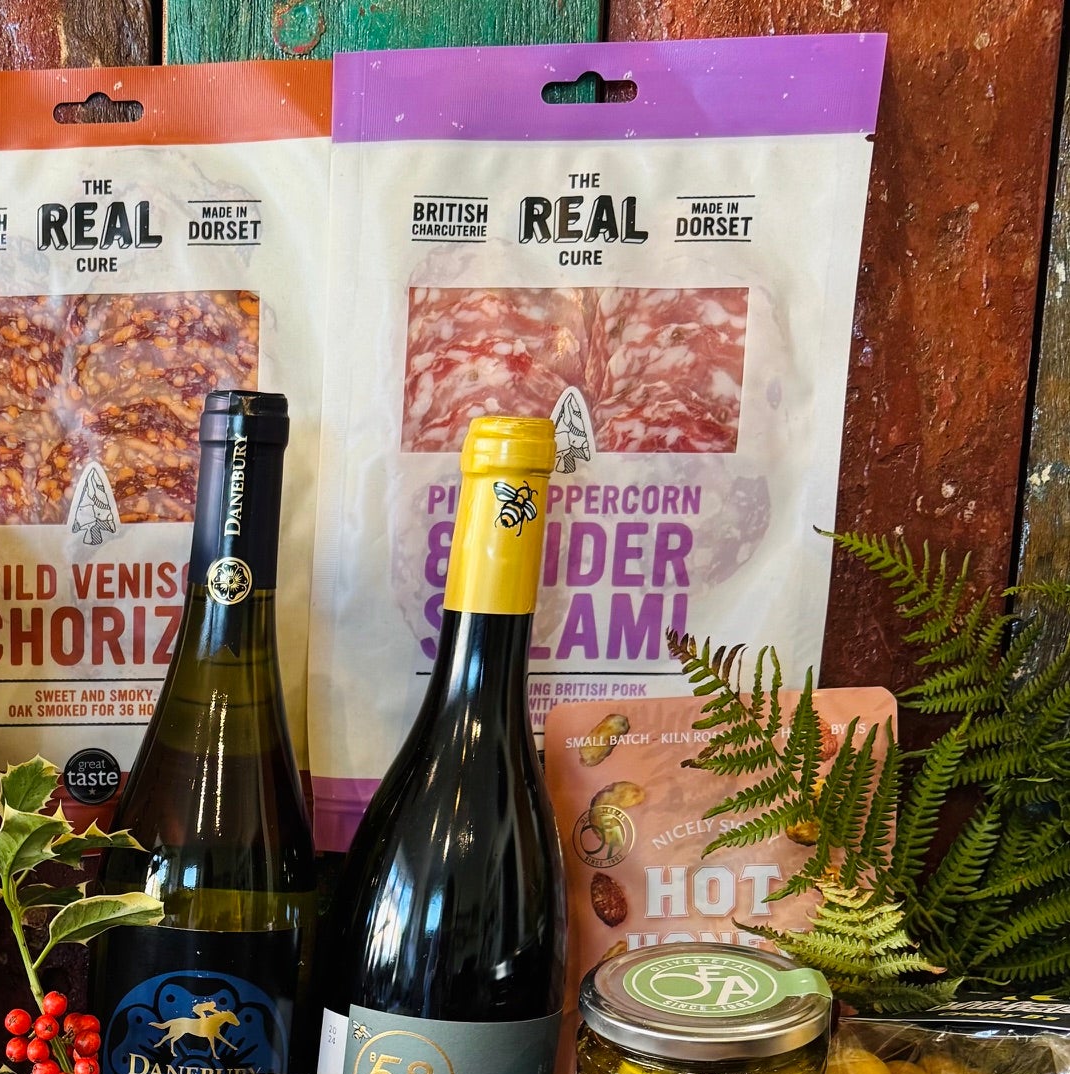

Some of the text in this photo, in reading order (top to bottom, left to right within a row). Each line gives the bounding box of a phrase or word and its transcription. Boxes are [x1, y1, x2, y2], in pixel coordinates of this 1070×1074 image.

[82, 180, 112, 195] THE
[568, 173, 600, 190] THE
[202, 205, 248, 219] MADE IN
[413, 203, 488, 223] BRITISH
[691, 202, 739, 215] MADE IN
[37, 201, 162, 251] REAL
[519, 195, 649, 245] REAL
[676, 216, 753, 237] DORSET
[188, 220, 261, 240] DORSET
[412, 223, 487, 237] CHARCUTERIE
[76, 257, 118, 273] CURE
[558, 250, 603, 266] CURE
[224, 432, 248, 537] DANEBURY
[72, 562, 190, 600] VENIS
[35, 689, 158, 703] SWEET AND SMOKY.
[555, 683, 647, 696] BRITISH PORK
[9, 704, 135, 718] OAK SMOKED FOR 36
[565, 731, 690, 749] SMALL BATCH KILN
[78, 758, 106, 772] great
[66, 767, 119, 789] taste
[651, 819, 715, 850] NICELY
[643, 864, 783, 919] HOT
